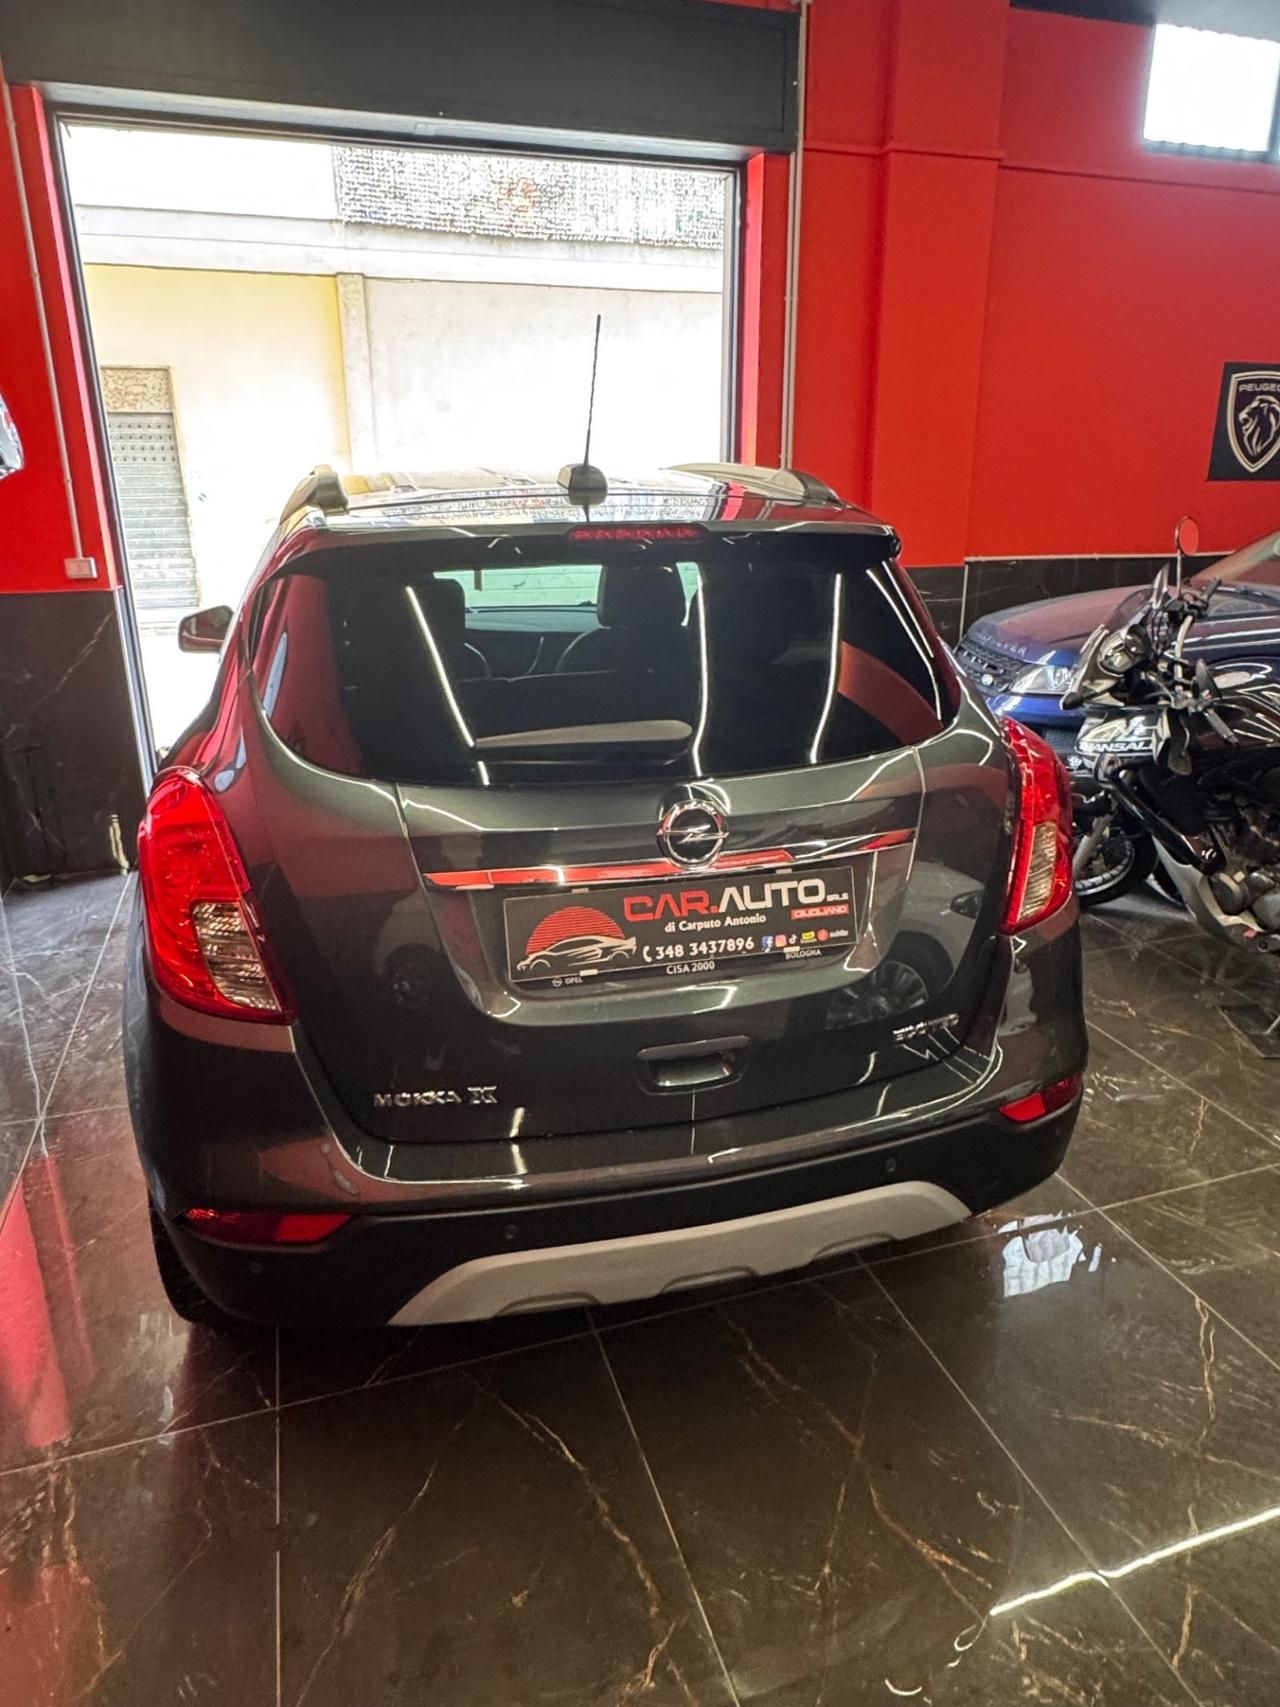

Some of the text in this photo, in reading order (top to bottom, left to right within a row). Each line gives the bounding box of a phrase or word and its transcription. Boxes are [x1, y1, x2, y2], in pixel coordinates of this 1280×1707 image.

[664, 912, 767, 933] di Carputo Antonio
[655, 944, 685, 960] 348
[689, 936, 755, 956] 3437896
[665, 961, 716, 975] CISA 2000
